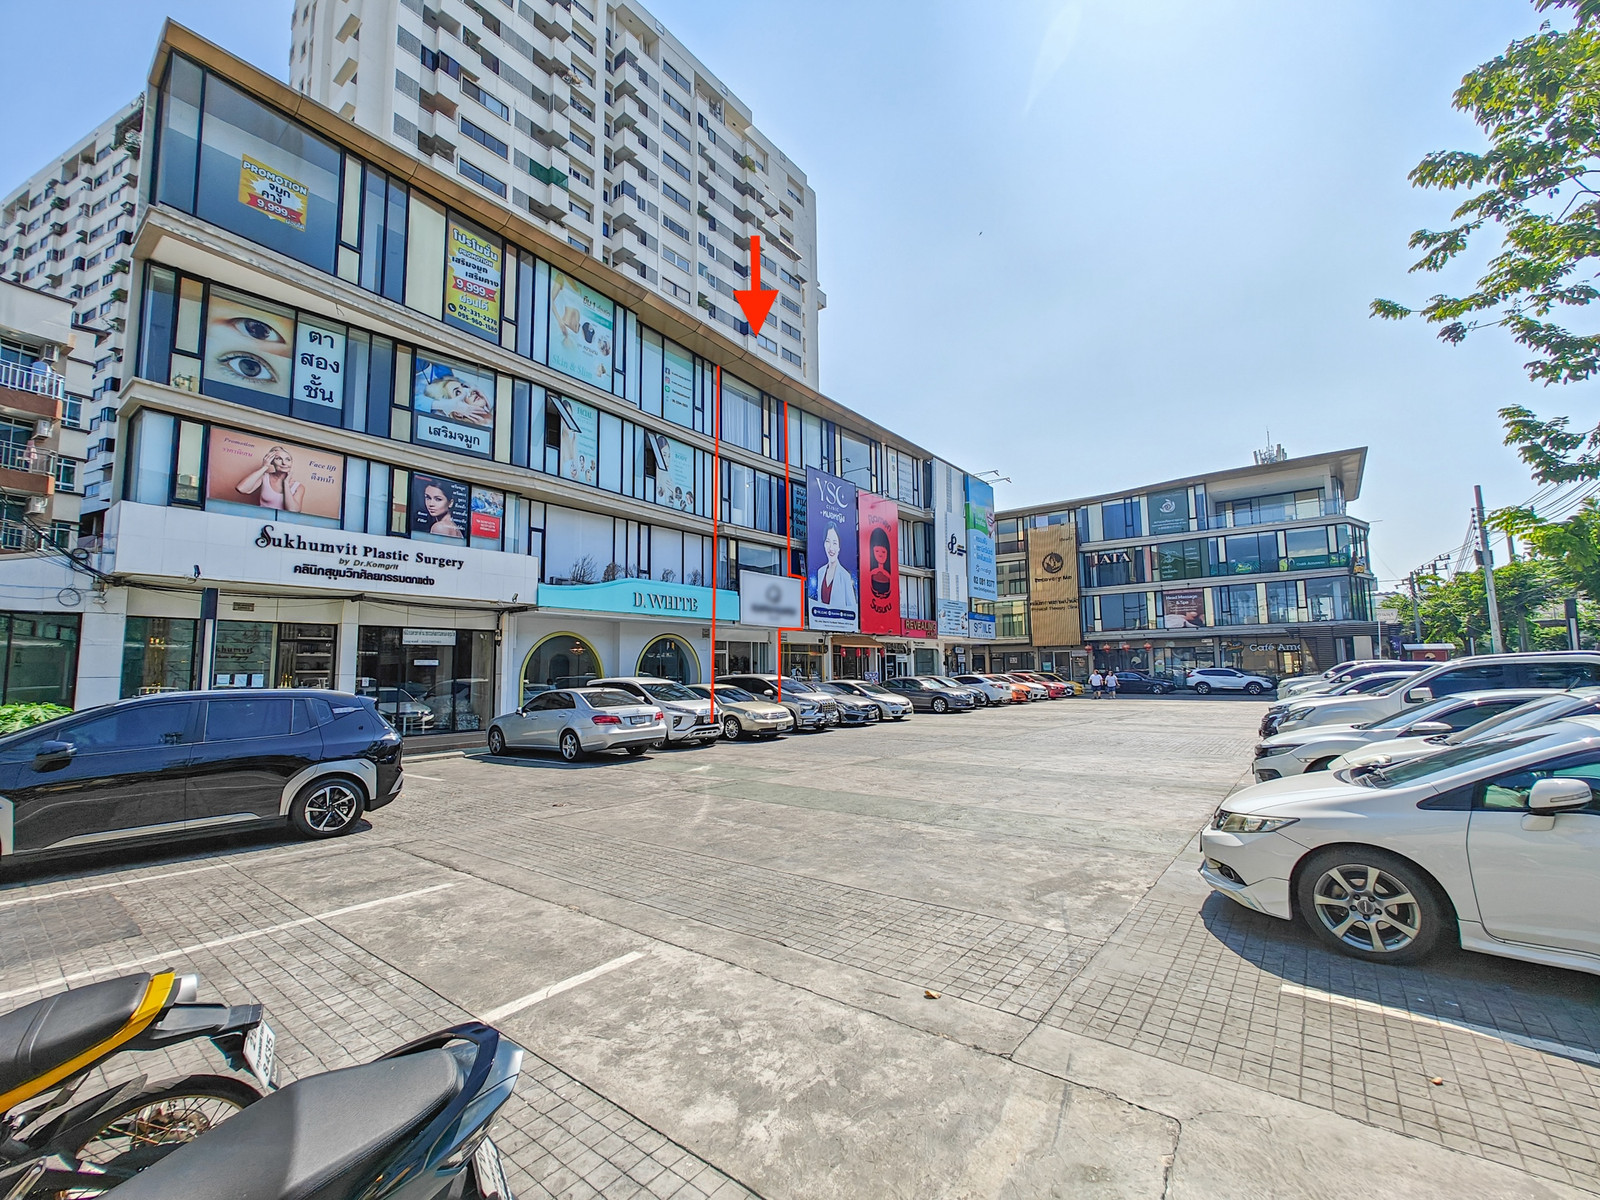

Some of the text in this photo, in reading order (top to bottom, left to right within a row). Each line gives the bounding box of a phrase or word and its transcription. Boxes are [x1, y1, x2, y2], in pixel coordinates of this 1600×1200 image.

[242, 160, 309, 197] PROMOTION
[262, 190, 283, 205] คาง
[257, 199, 297, 219] 9,999.-
[453, 228, 499, 262] โปรโมชั่น
[452, 257, 488, 274] เสริมจมูก
[458, 247, 494, 268] PROMOTION
[456, 279, 494, 299] 9,999.-
[465, 271, 499, 288] เสริมคาง
[309, 331, 335, 349] ตา
[300, 353, 340, 373] สอง
[303, 373, 334, 403] ชั้น
[224, 437, 255, 448] Promotion
[428, 425, 480, 448] เสริมจมูก
[308, 460, 337, 472] Face lift
[310, 472, 335, 485] ดึงหน้า
[816, 477, 848, 509] YSC
[255, 525, 465, 569] Sukhumvit Plastic Surgery
[338, 557, 400, 571] by Dr.Komgrit
[293, 563, 435, 586] คลินิกสุขุมวิทศัลยกรรมตกแต่ง
[633, 592, 699, 612] D. WHITE
[905, 620, 937, 632] REVEALING
[1249, 643, 1275, 652] Café
